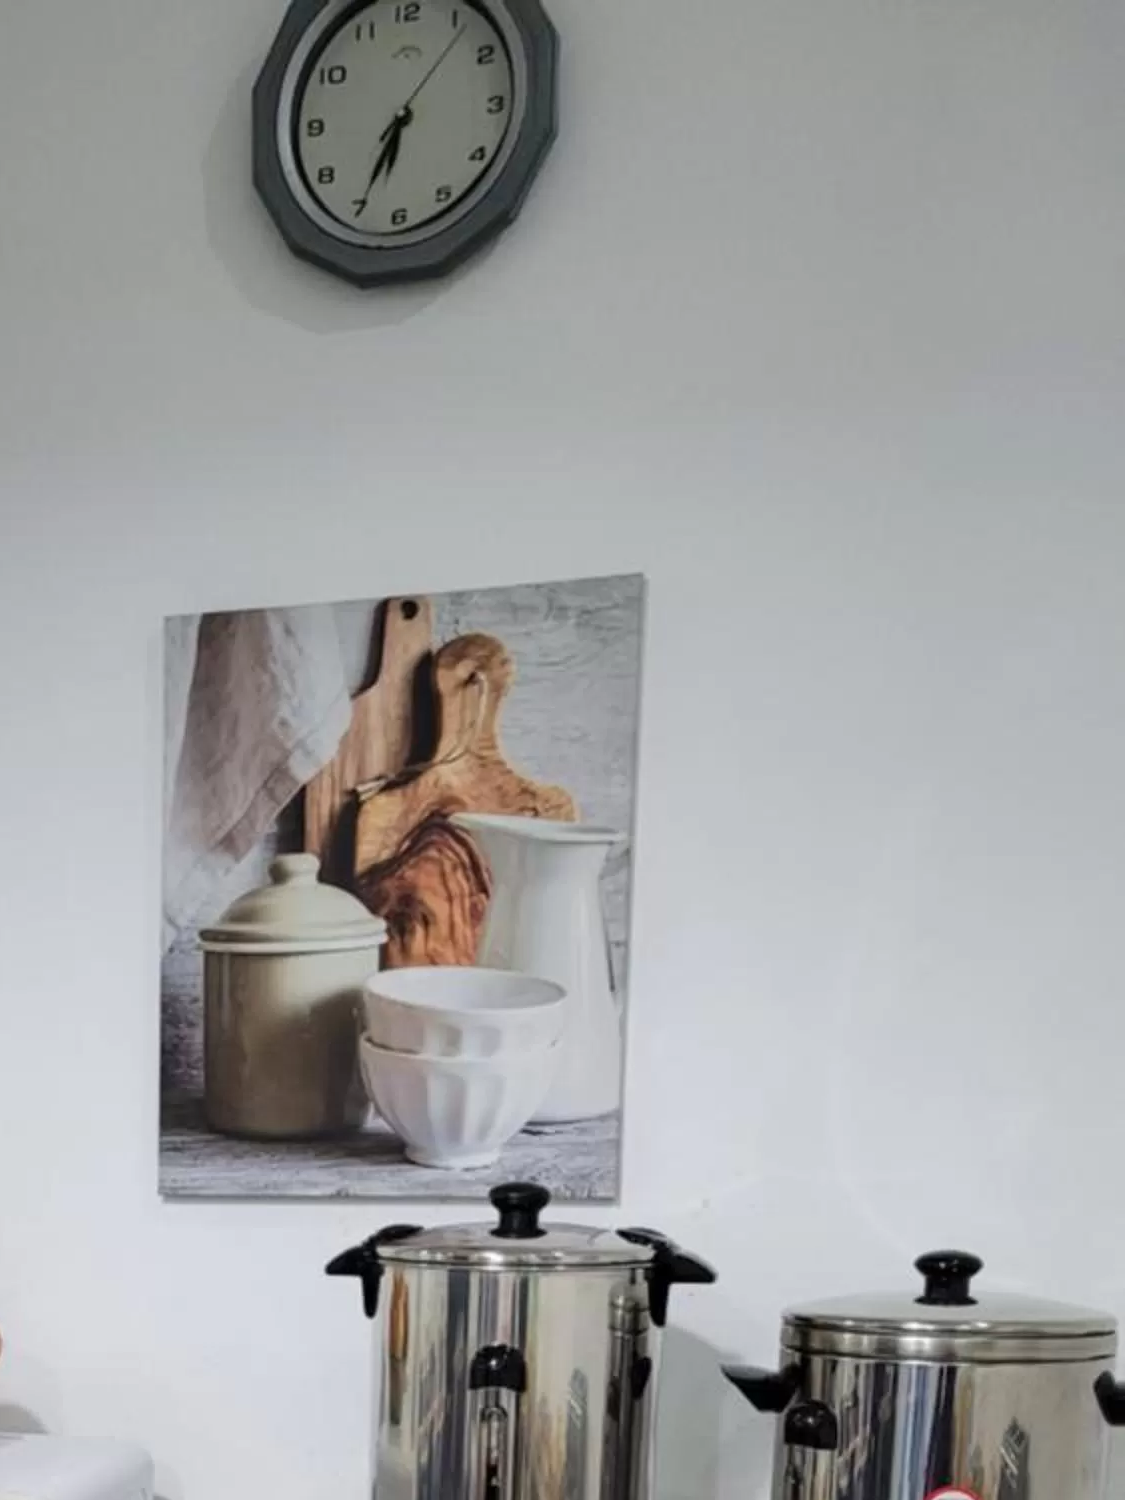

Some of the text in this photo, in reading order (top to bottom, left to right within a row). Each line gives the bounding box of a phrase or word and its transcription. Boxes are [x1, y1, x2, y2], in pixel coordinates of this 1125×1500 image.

[394, 2, 421, 24] 12
[451, 9, 458, 28] 1
[355, 22, 374, 41] 11
[476, 45, 495, 65] 2
[319, 65, 347, 85] 10
[487, 96, 504, 114] 3
[307, 119, 325, 137] 9
[468, 146, 486, 163] 4
[318, 167, 335, 184] 8
[435, 186, 452, 203] 5
[352, 199, 367, 217] 7
[391, 208, 407, 226] 6
